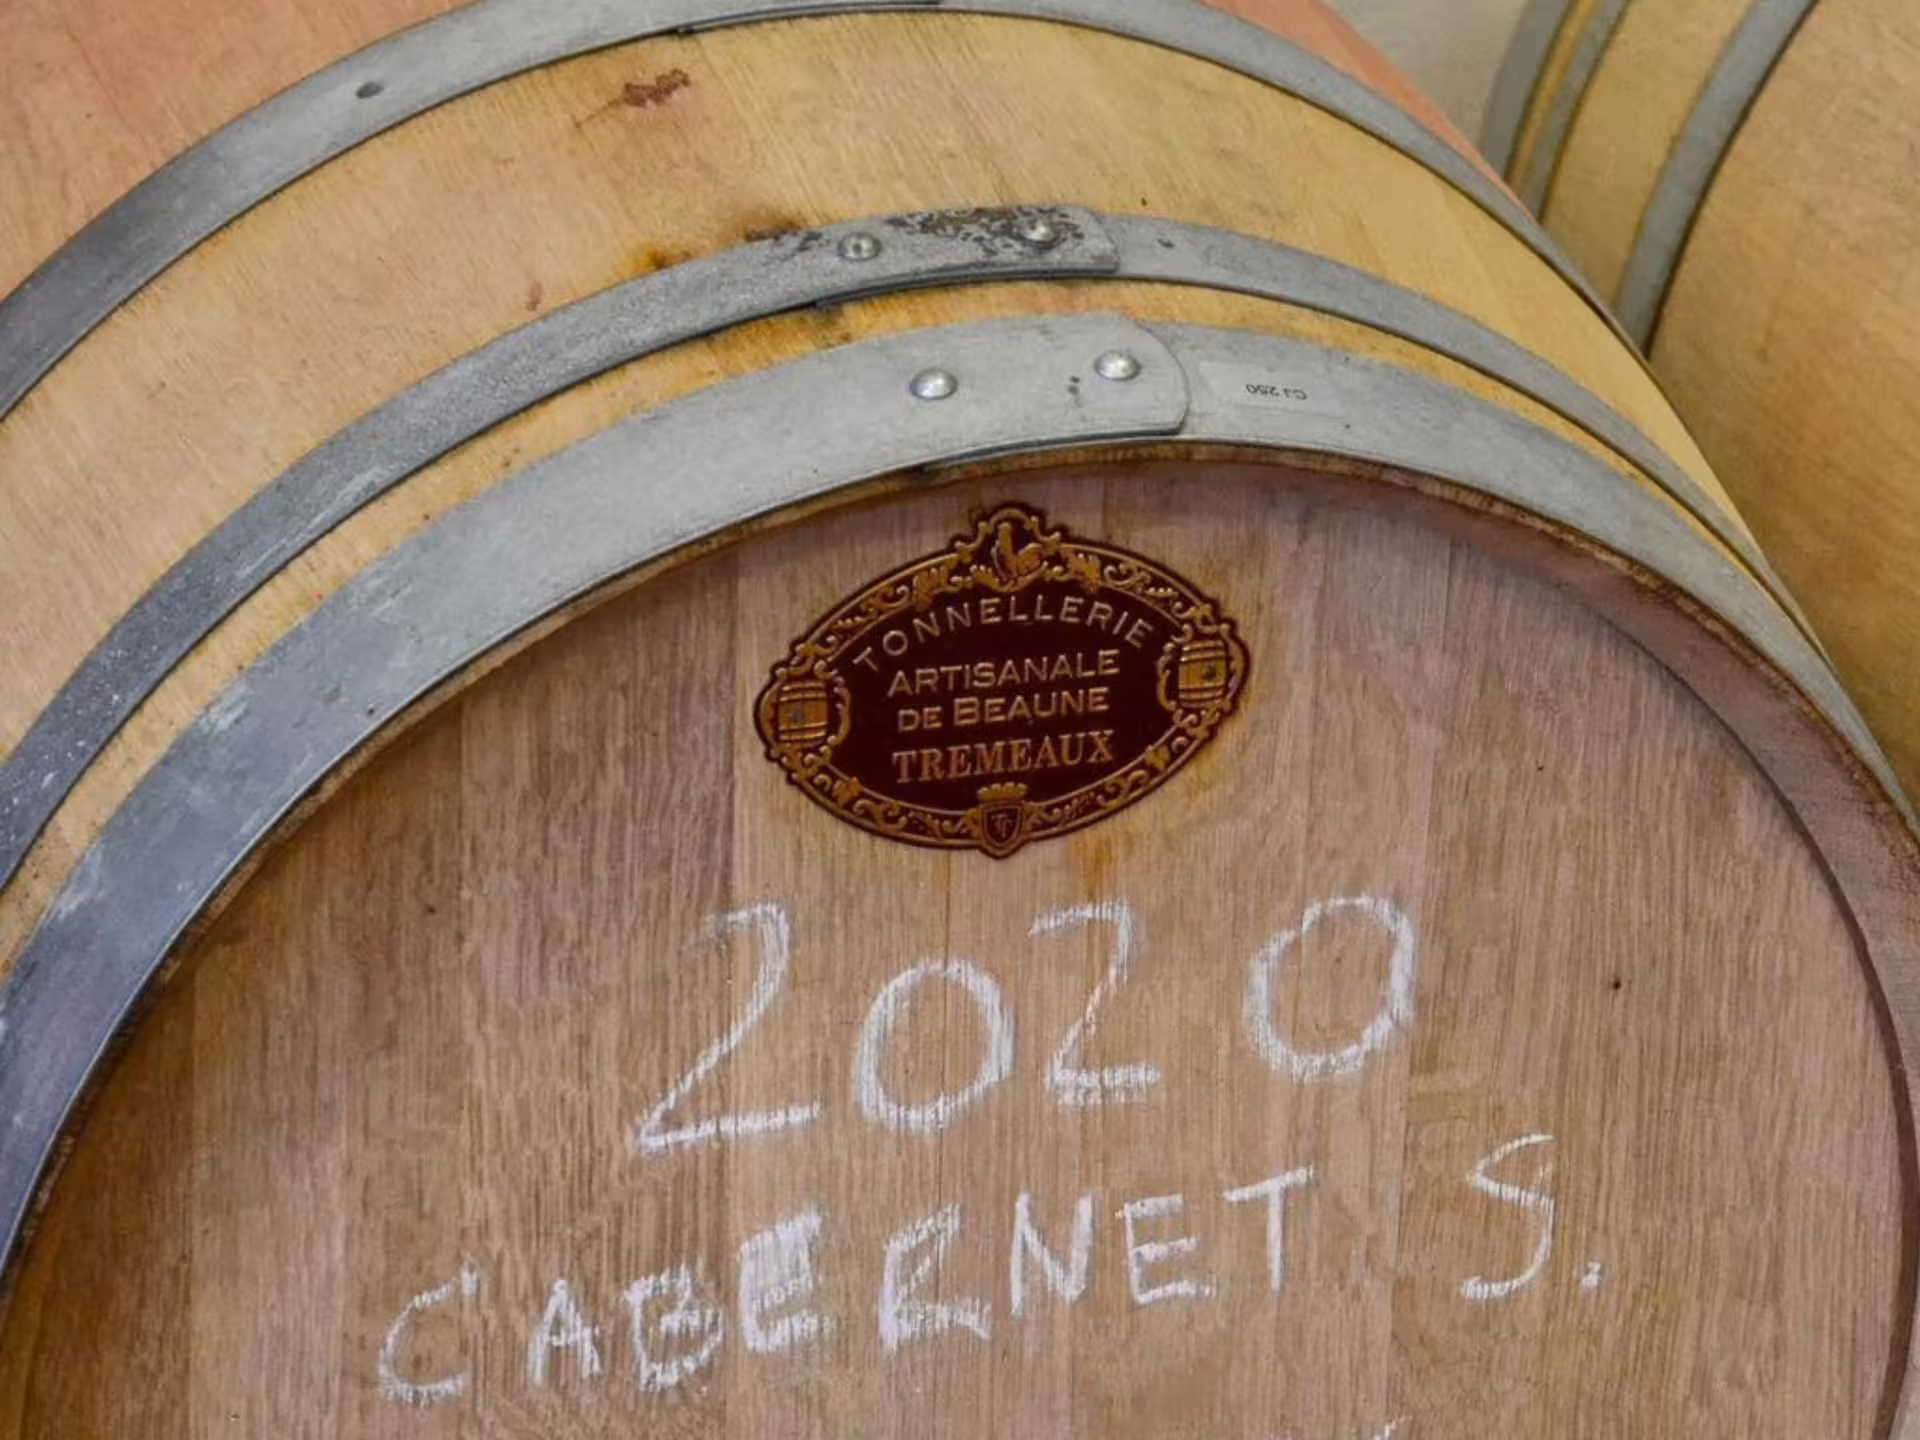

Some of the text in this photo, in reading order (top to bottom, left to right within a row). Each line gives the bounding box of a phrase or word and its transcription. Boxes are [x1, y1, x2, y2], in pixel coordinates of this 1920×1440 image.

[852, 594, 1154, 673] TONNELLERIE
[887, 649, 1120, 698] ARTISANALE
[898, 687, 1110, 733] DE BEAUNE
[891, 730, 1115, 785] TREMEAUX
[627, 896, 1417, 1160] 2020
